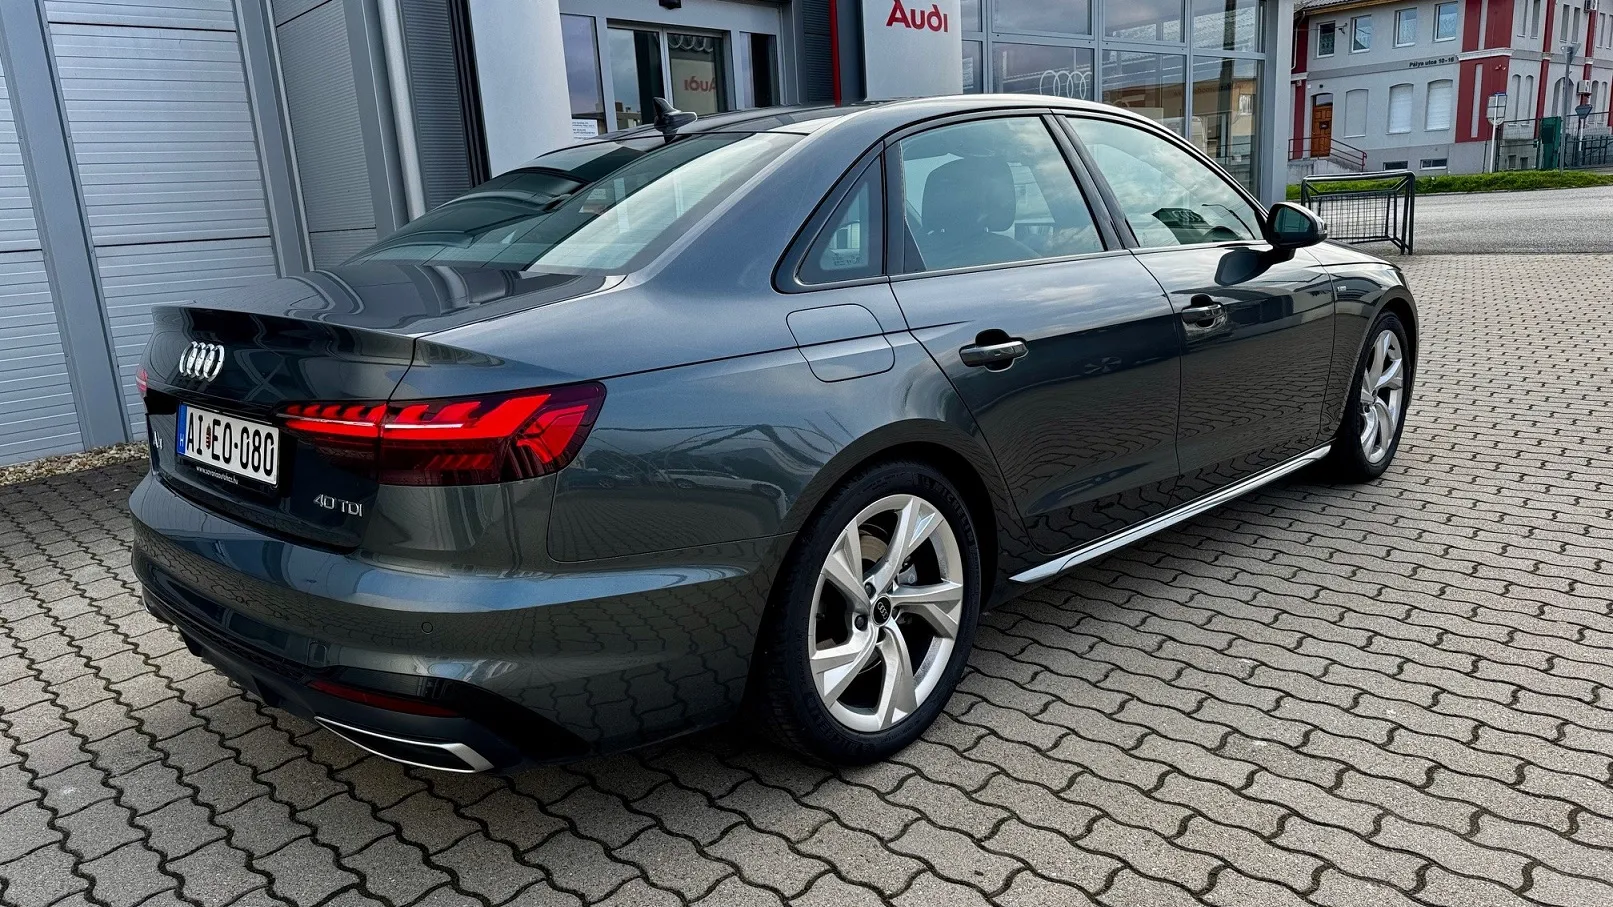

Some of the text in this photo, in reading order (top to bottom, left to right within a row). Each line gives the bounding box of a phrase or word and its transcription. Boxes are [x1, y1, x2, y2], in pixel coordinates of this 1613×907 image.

[886, 0, 948, 32] Audi
[313, 494, 362, 517] 40 TDI
